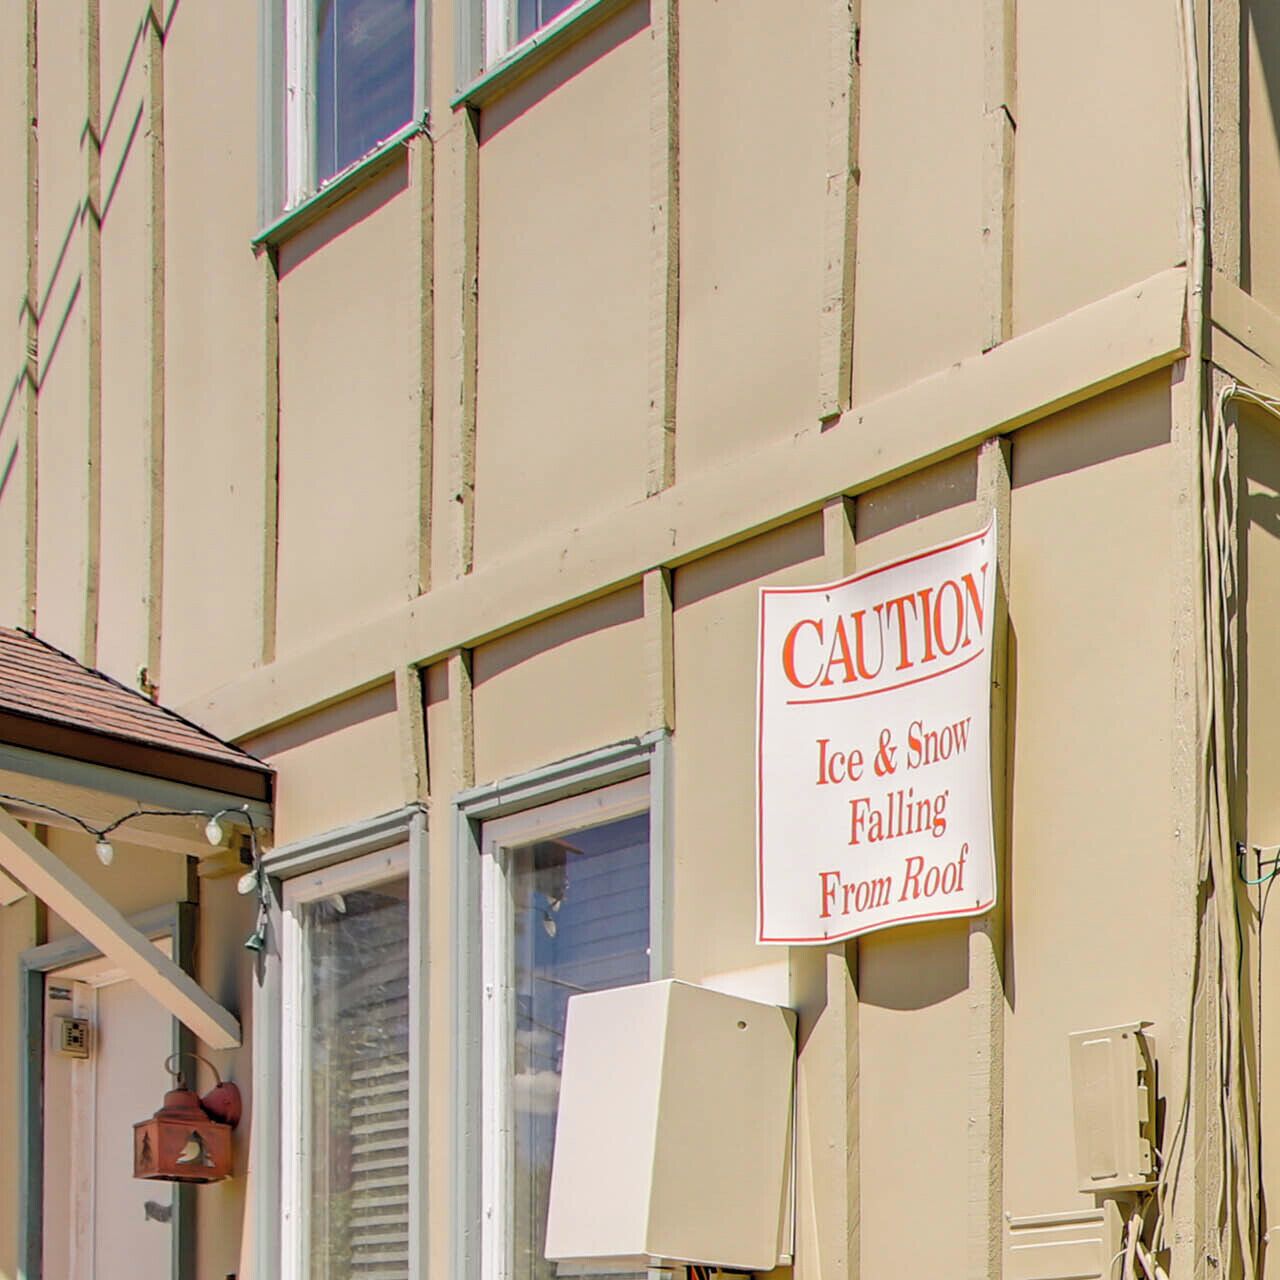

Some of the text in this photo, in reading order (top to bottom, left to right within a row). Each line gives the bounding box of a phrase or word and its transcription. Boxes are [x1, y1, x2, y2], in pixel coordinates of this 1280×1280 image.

[782, 562, 989, 689] CAUTION
[816, 717, 971, 785] Ice & Snow
[848, 787, 949, 845] Falling
[819, 843, 969, 918] From Roof
